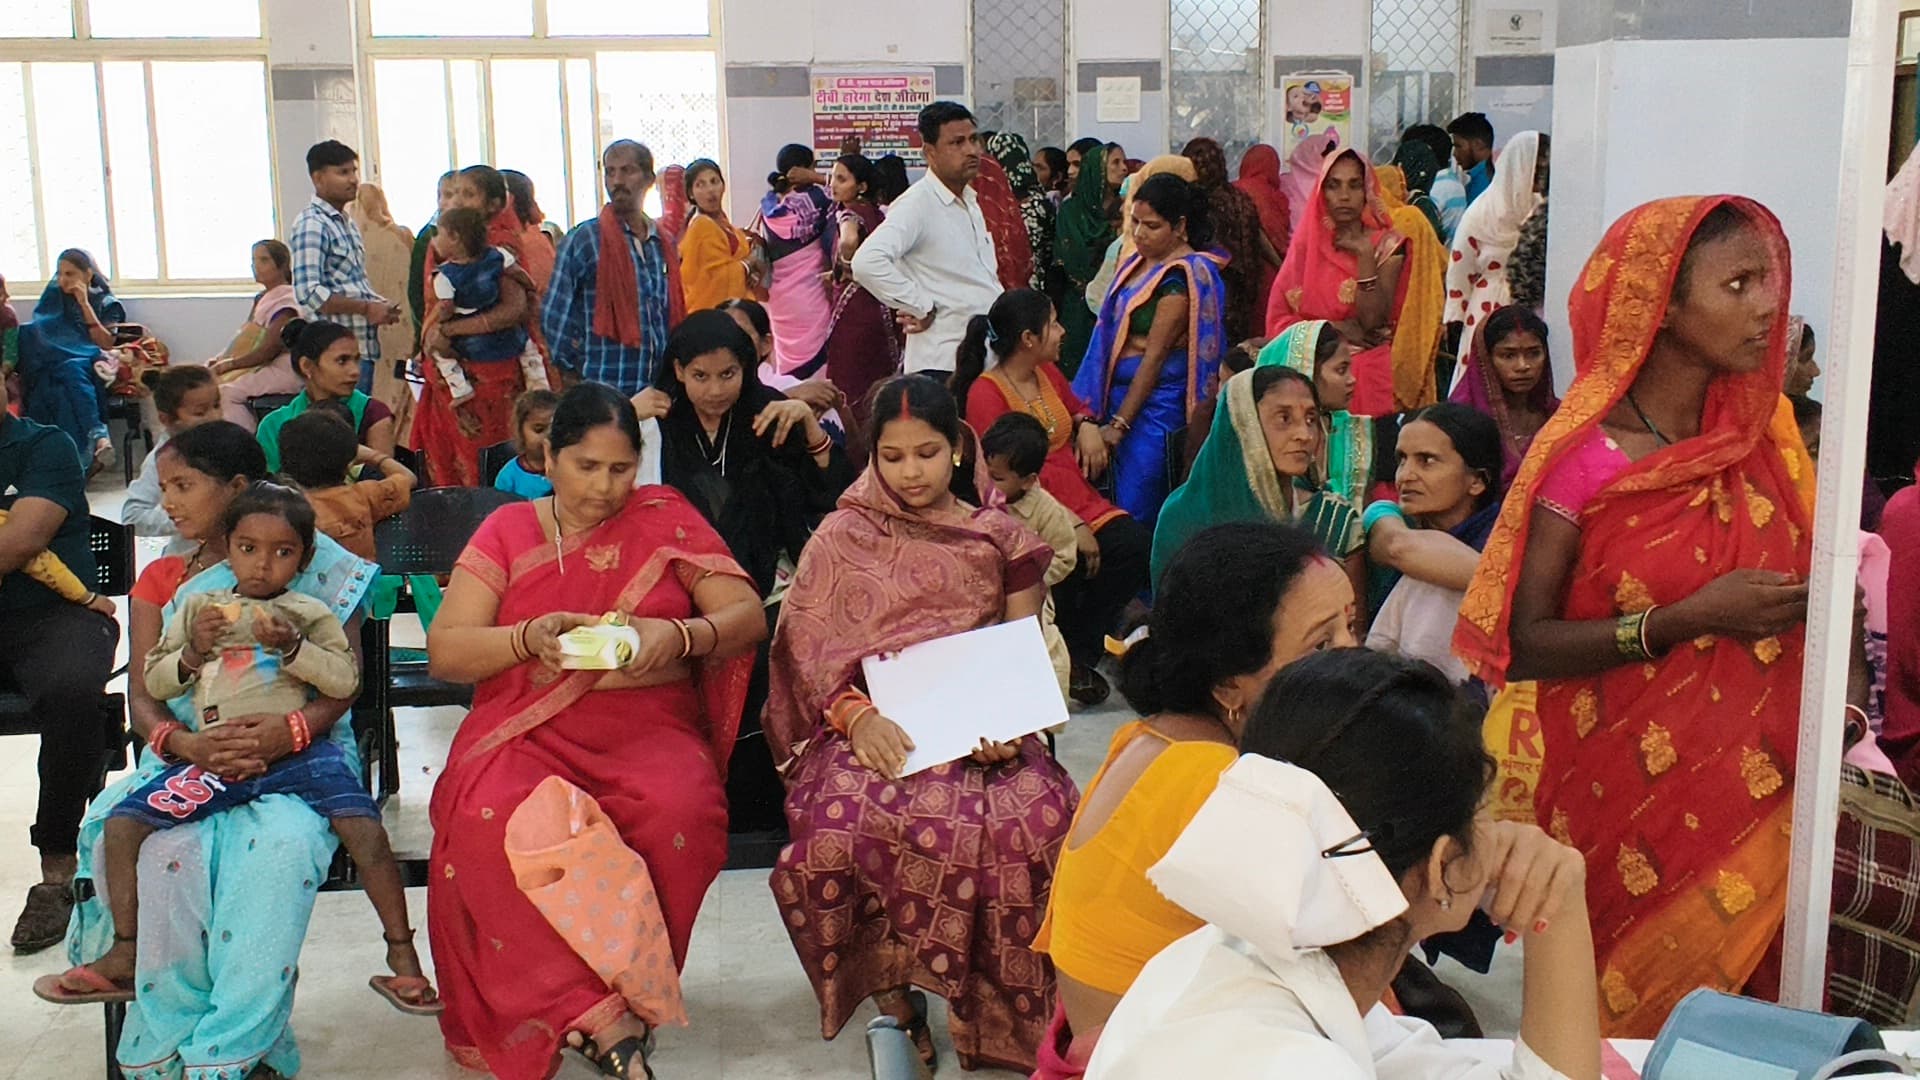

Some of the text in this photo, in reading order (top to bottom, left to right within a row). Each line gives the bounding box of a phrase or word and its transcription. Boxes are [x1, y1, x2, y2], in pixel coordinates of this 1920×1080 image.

[816, 88, 929, 104] टीबी हारेगा देश जीतेगा
[1509, 708, 1542, 759] R
